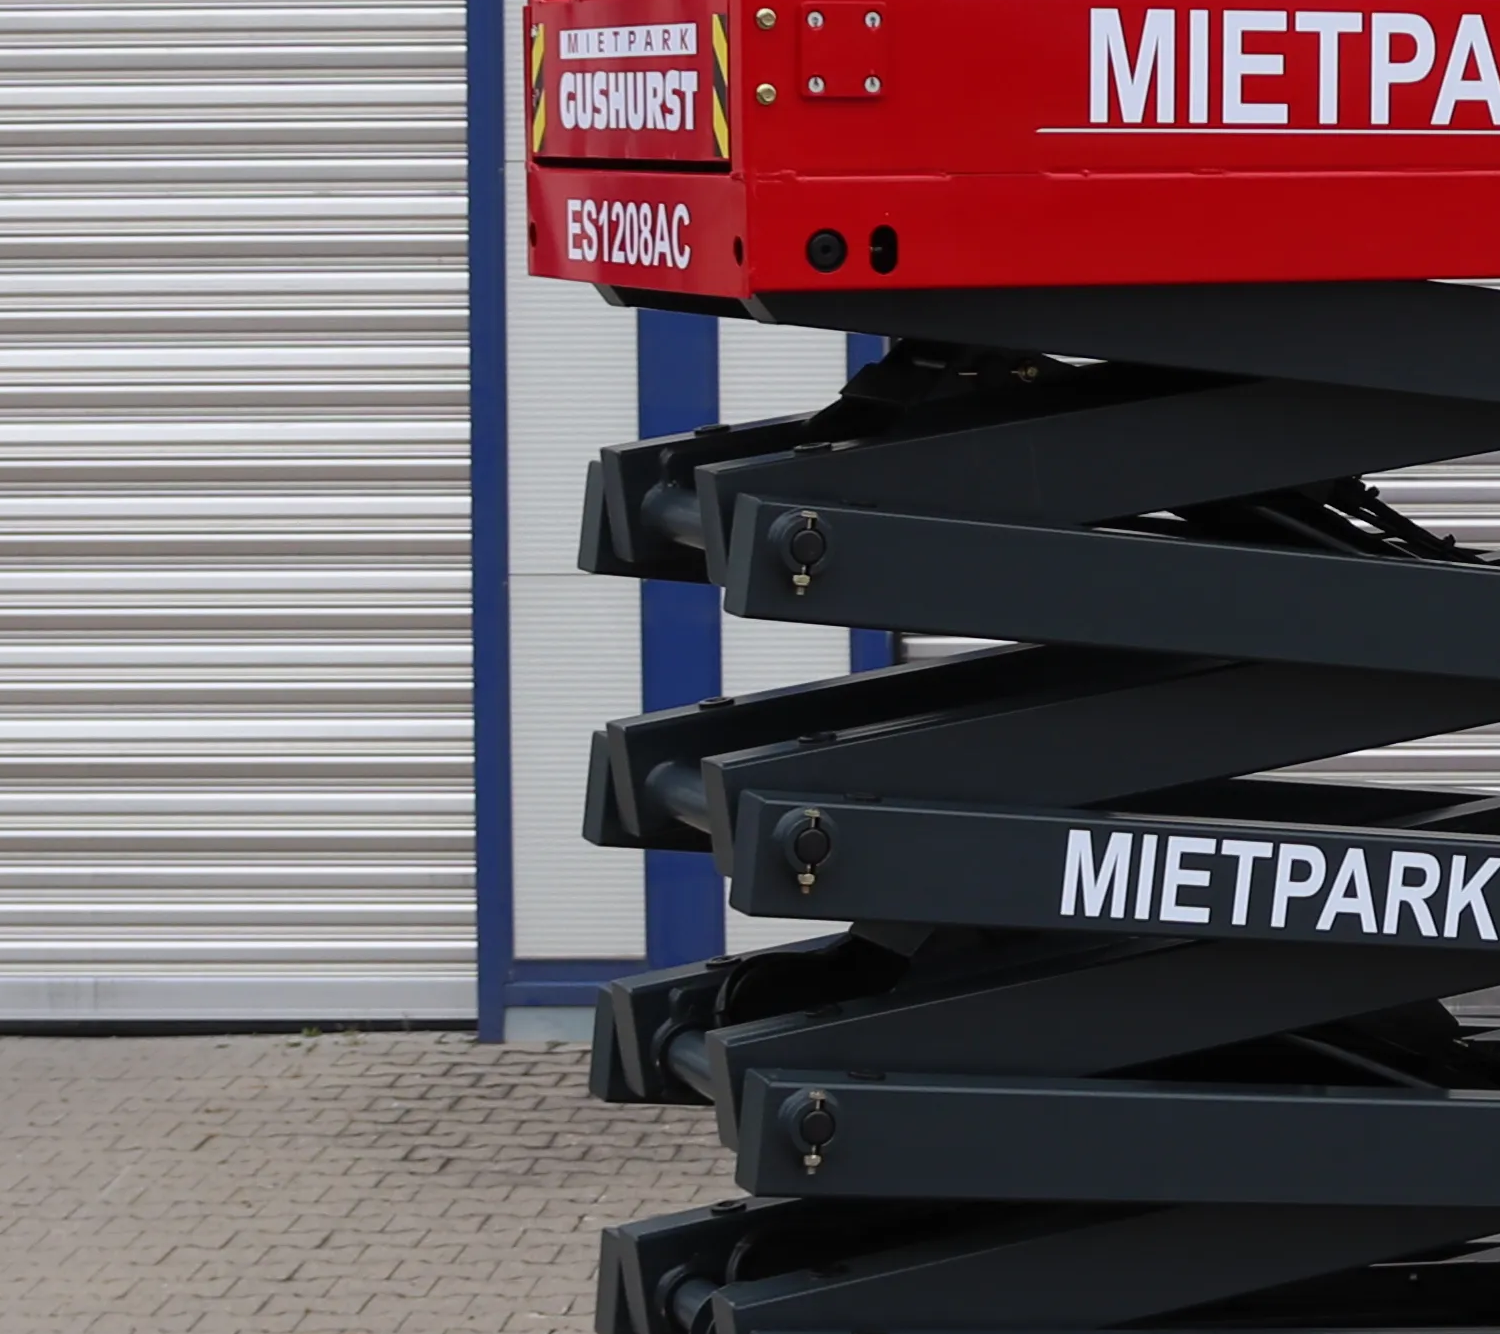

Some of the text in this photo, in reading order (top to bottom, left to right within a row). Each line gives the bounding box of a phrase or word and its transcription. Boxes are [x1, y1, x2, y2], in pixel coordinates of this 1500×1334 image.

[567, 28, 690, 54] MIETPARK
[560, 70, 698, 131] GUSHURST
[566, 198, 691, 270] ES1208AC
